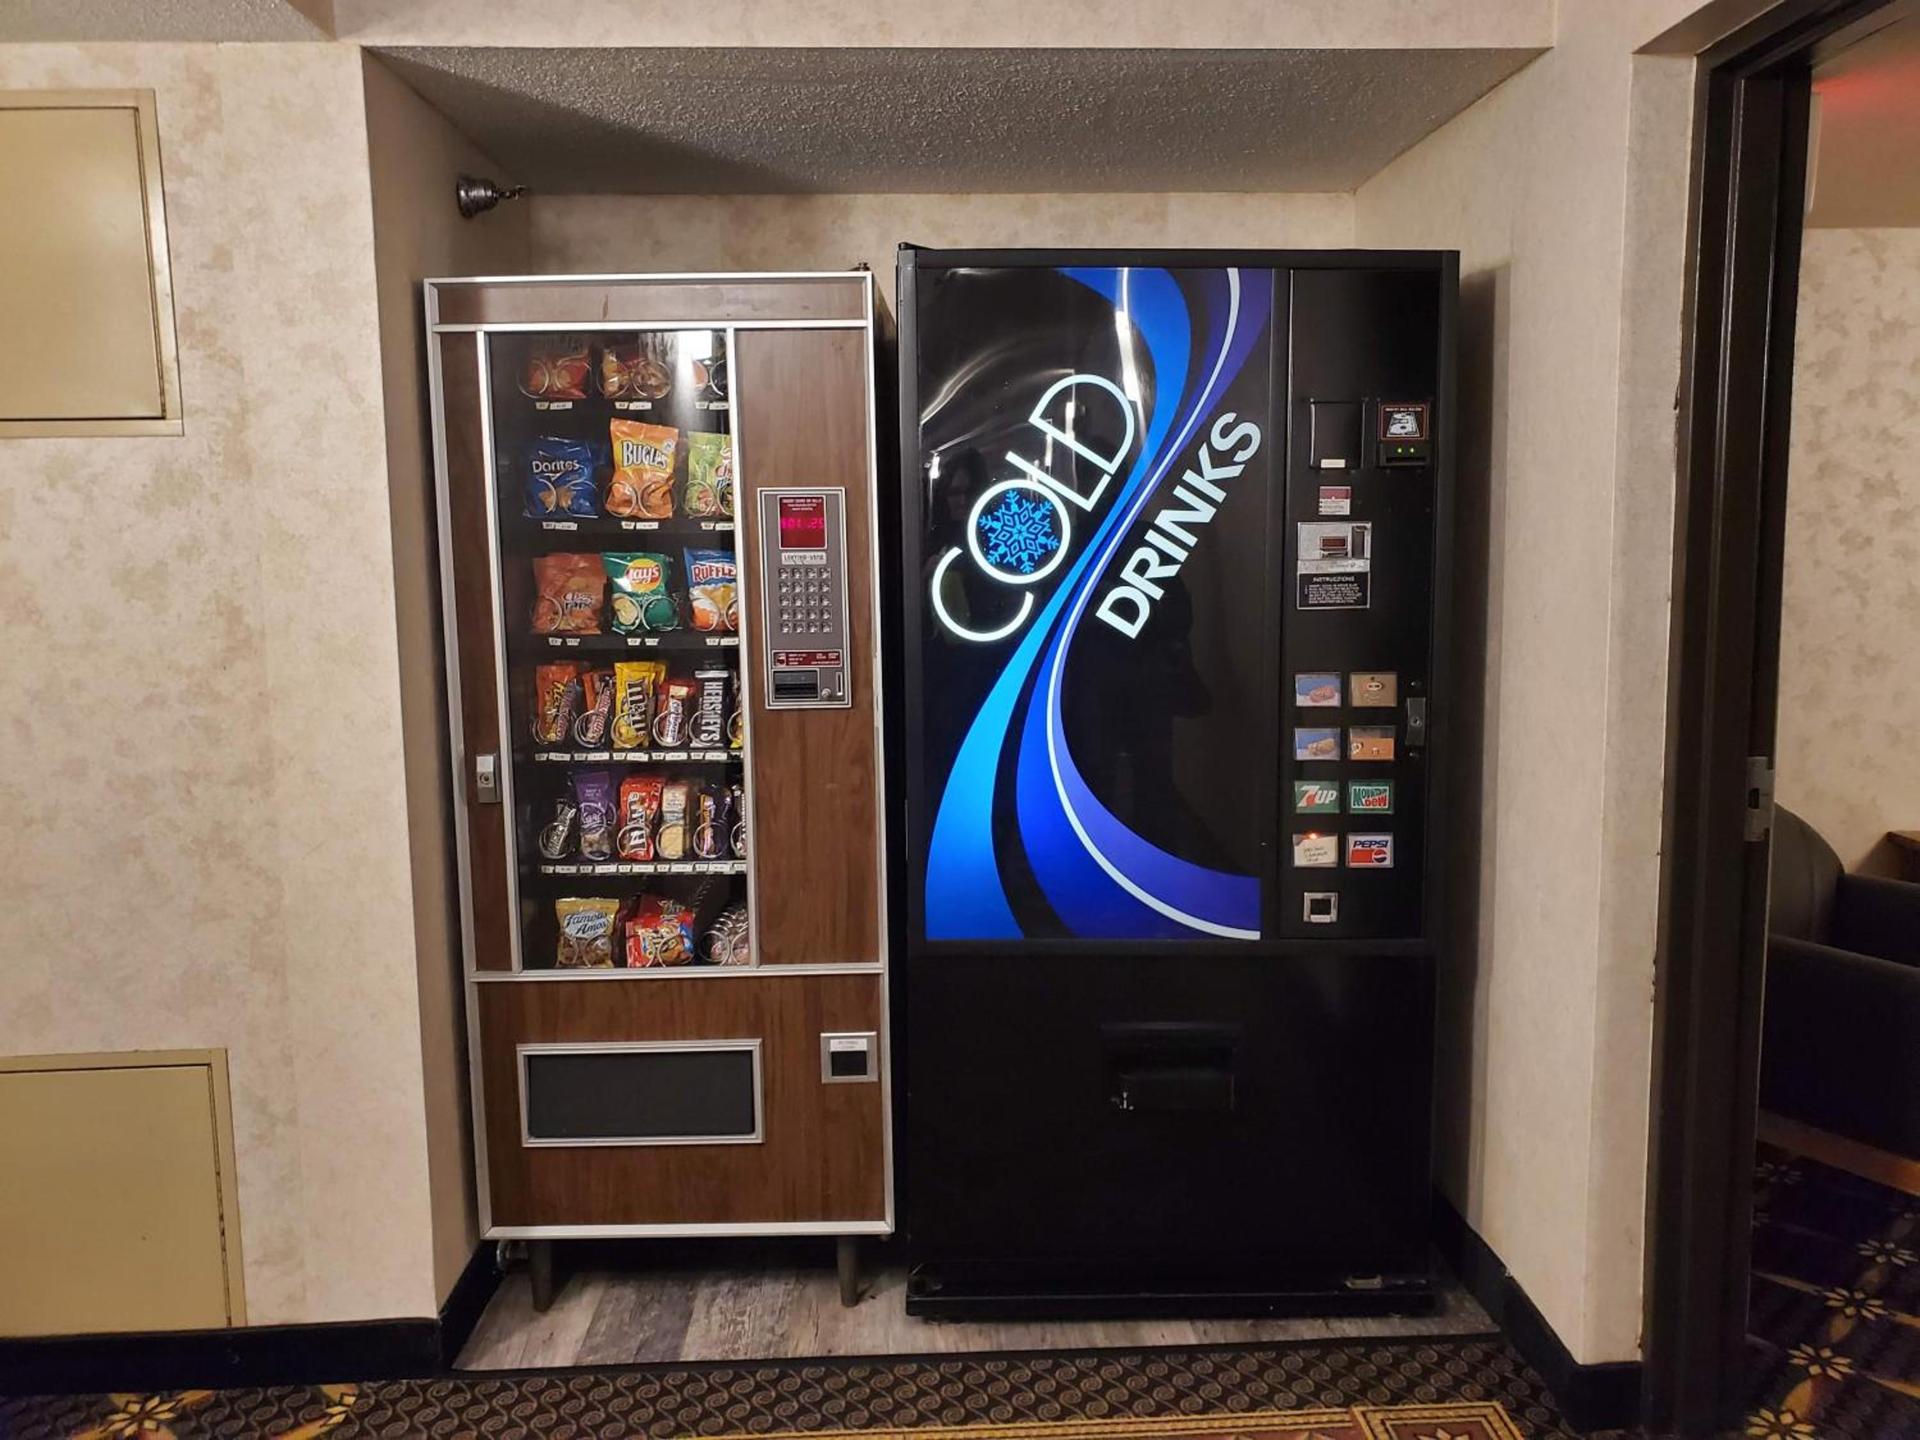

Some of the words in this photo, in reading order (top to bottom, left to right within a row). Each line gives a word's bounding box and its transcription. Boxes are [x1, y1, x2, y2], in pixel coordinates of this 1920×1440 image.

[622, 440, 669, 469] BUGLES
[532, 459, 579, 473] Doritos
[932, 374, 1135, 642] COLD
[1096, 412, 1262, 640] DRINKS
[692, 562, 737, 583] RUFFLE
[1297, 785, 1337, 807] 7UP
[1353, 839, 1389, 849] PEPSI
[565, 911, 608, 927] Famous
[576, 921, 608, 935] Amos
